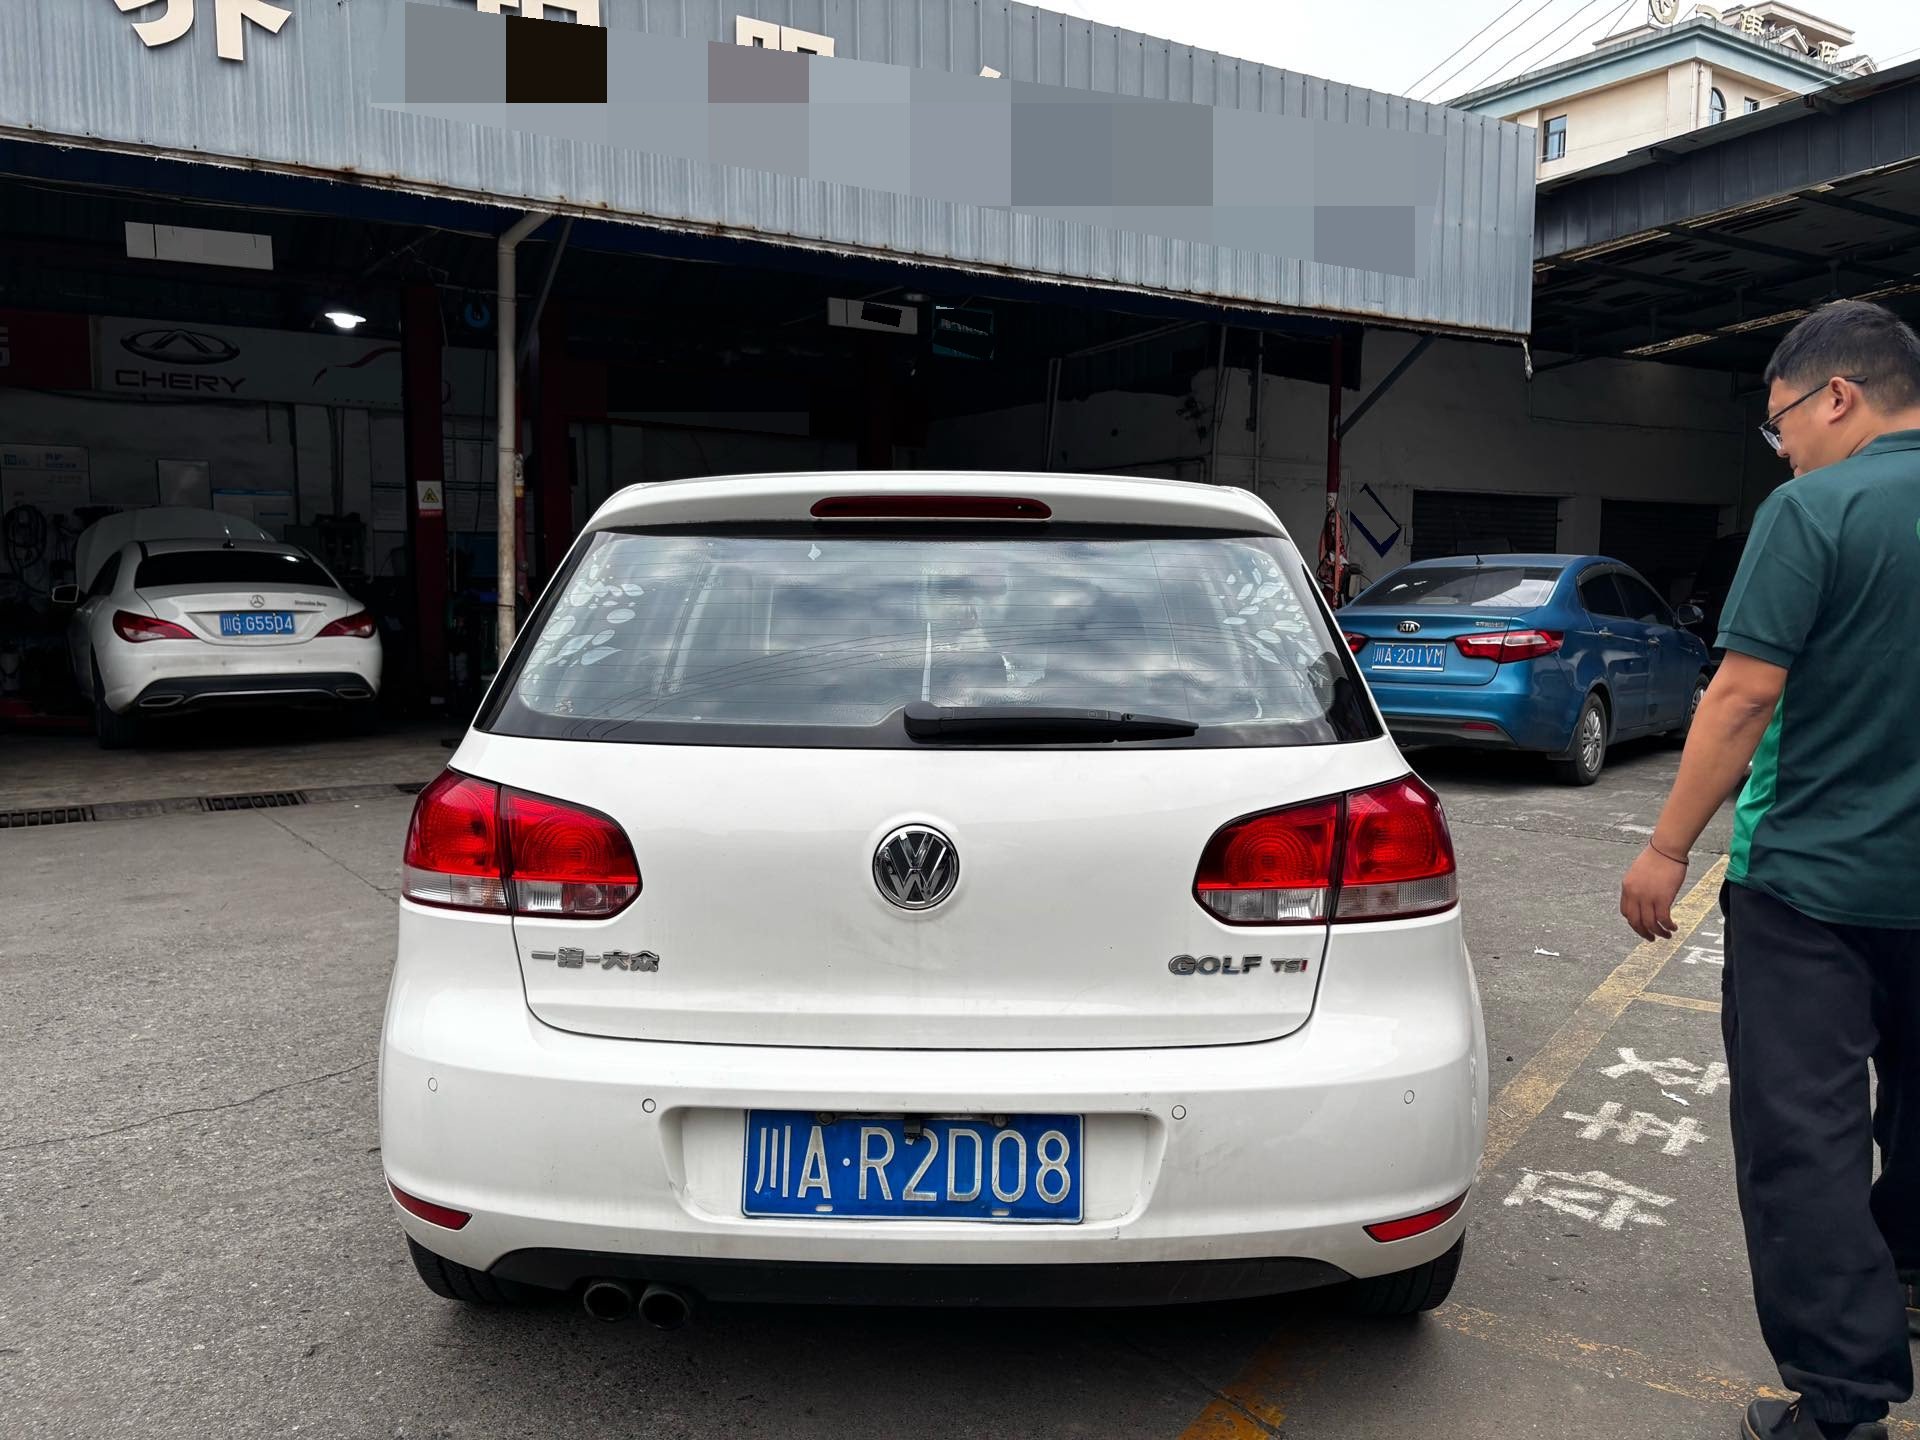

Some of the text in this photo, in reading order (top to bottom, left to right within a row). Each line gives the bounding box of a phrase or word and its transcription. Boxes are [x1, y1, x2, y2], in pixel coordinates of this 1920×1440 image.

[115, 369, 247, 394] CHERY
[1400, 622, 1417, 633] KIA
[1168, 954, 1263, 976] GOLF
[753, 1124, 1071, 1204] 川A·R2D08
